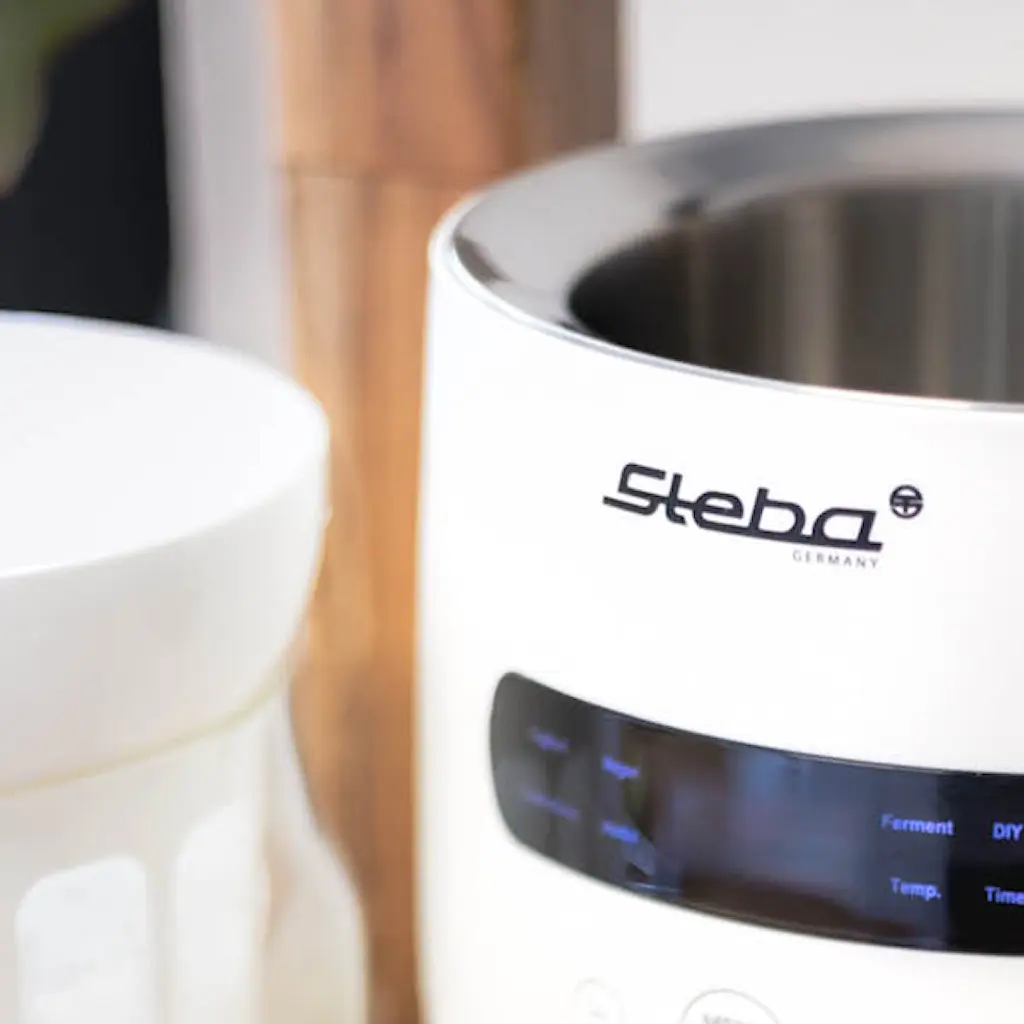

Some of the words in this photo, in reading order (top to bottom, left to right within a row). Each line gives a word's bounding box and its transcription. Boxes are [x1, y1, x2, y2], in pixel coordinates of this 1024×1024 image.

[603, 462, 883, 552] Steba
[793, 550, 879, 570] GERMANY
[881, 813, 954, 836] Ferment
[992, 822, 1024, 841] DIY
[890, 877, 941, 901] Temp.
